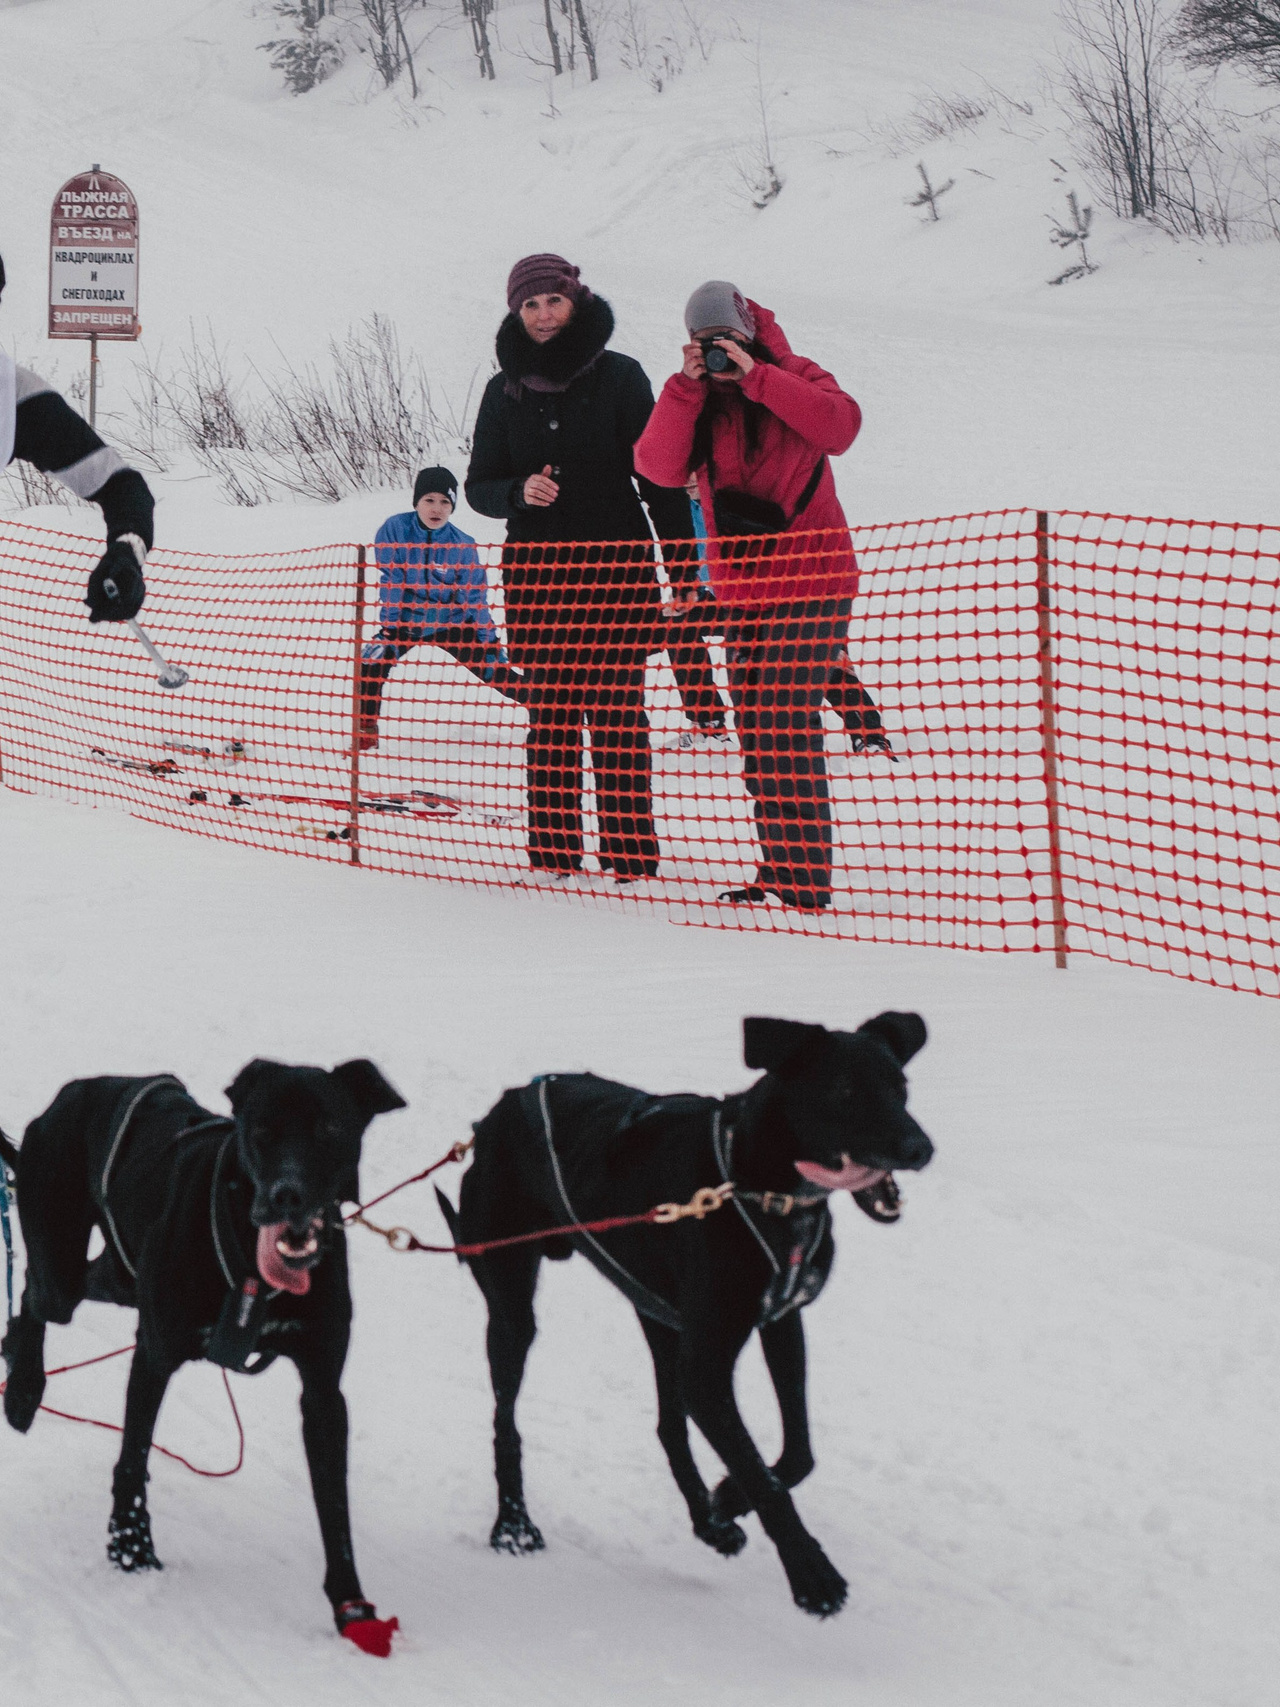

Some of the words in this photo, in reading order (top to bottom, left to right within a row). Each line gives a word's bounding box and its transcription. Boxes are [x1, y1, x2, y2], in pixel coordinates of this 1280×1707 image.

[60, 191, 129, 203] ЛЫЖНАЯ
[61, 205, 130, 219] ТРАССА
[58, 227, 113, 241] ВЪЕЗД
[117, 232, 132, 240] НА
[55, 252, 134, 265] КВАДРОЦИКЛАХ
[91, 271, 98, 281] И
[62, 288, 125, 302] СНЕГОХОДАХ
[53, 312, 132, 327] ЗАПРЕЩЕН
